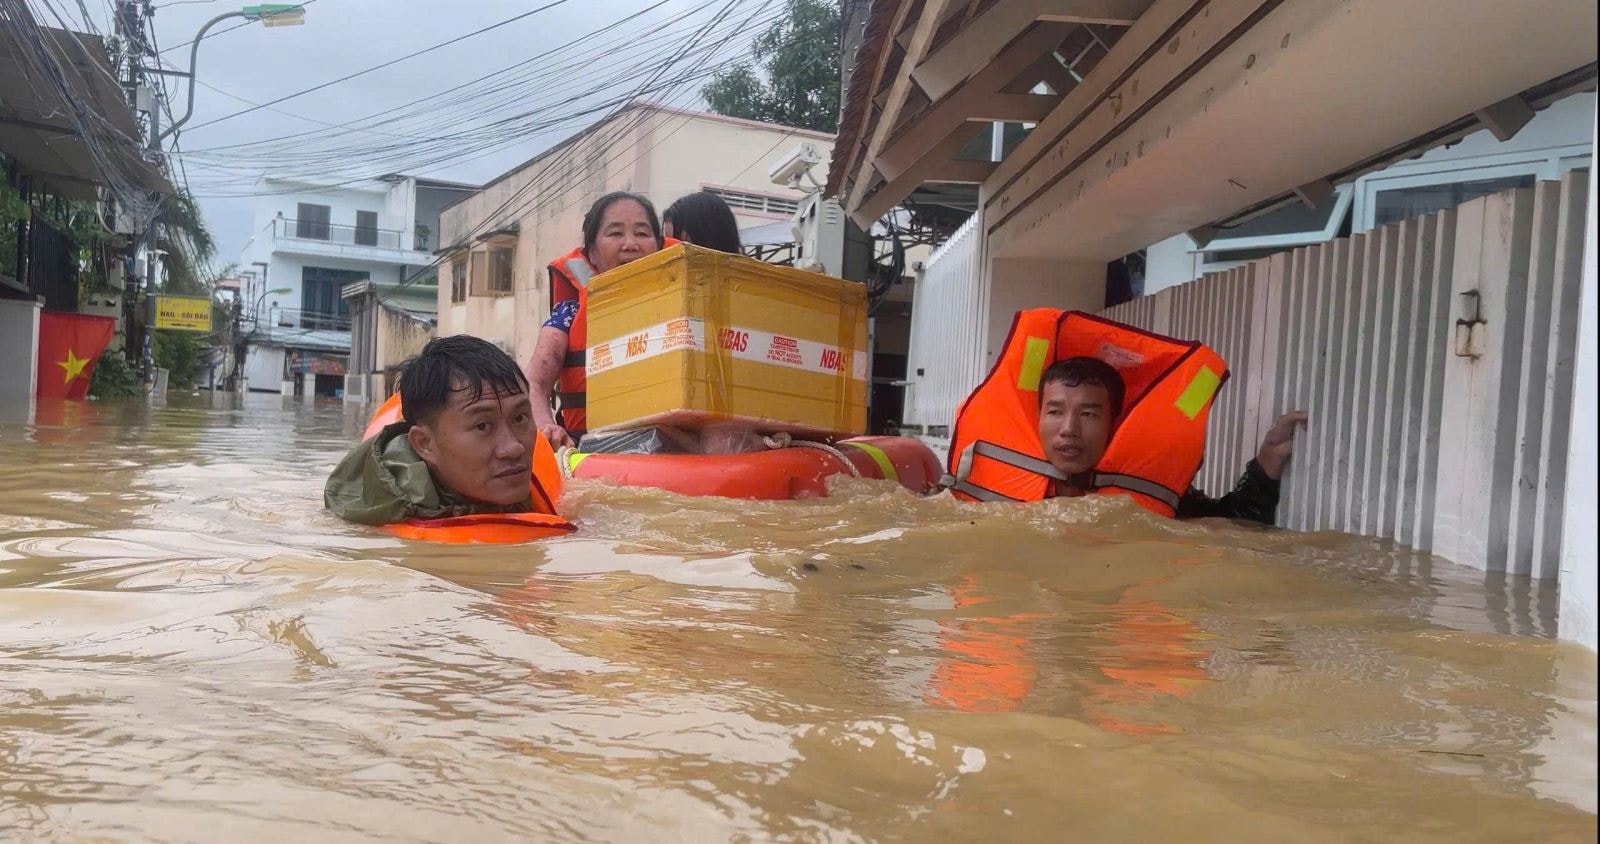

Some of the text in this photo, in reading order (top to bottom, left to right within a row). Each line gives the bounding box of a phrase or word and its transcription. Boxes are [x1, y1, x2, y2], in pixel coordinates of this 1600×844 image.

[626, 333, 649, 358] NBAS
[718, 327, 749, 353] NBAS
[819, 348, 848, 371] NBAS
